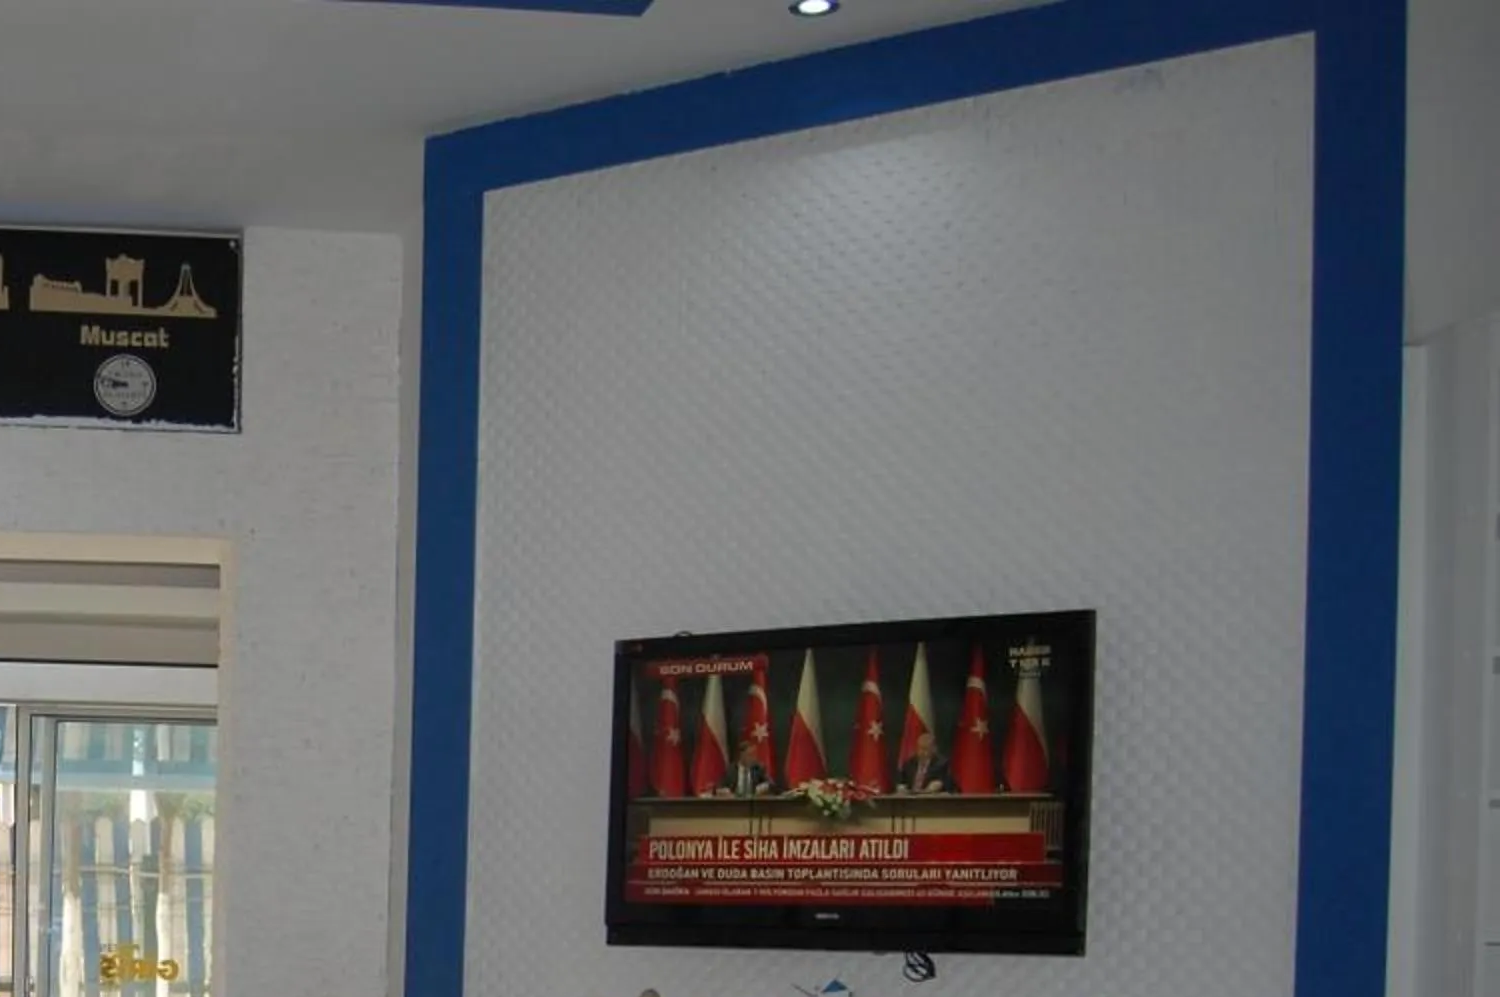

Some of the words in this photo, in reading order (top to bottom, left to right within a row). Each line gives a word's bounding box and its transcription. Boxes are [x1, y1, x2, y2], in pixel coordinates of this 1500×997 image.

[79, 324, 170, 349] Muscat
[649, 838, 713, 861] POLONYA
[858, 838, 909, 860] ATILDI
[701, 868, 715, 879] VE
